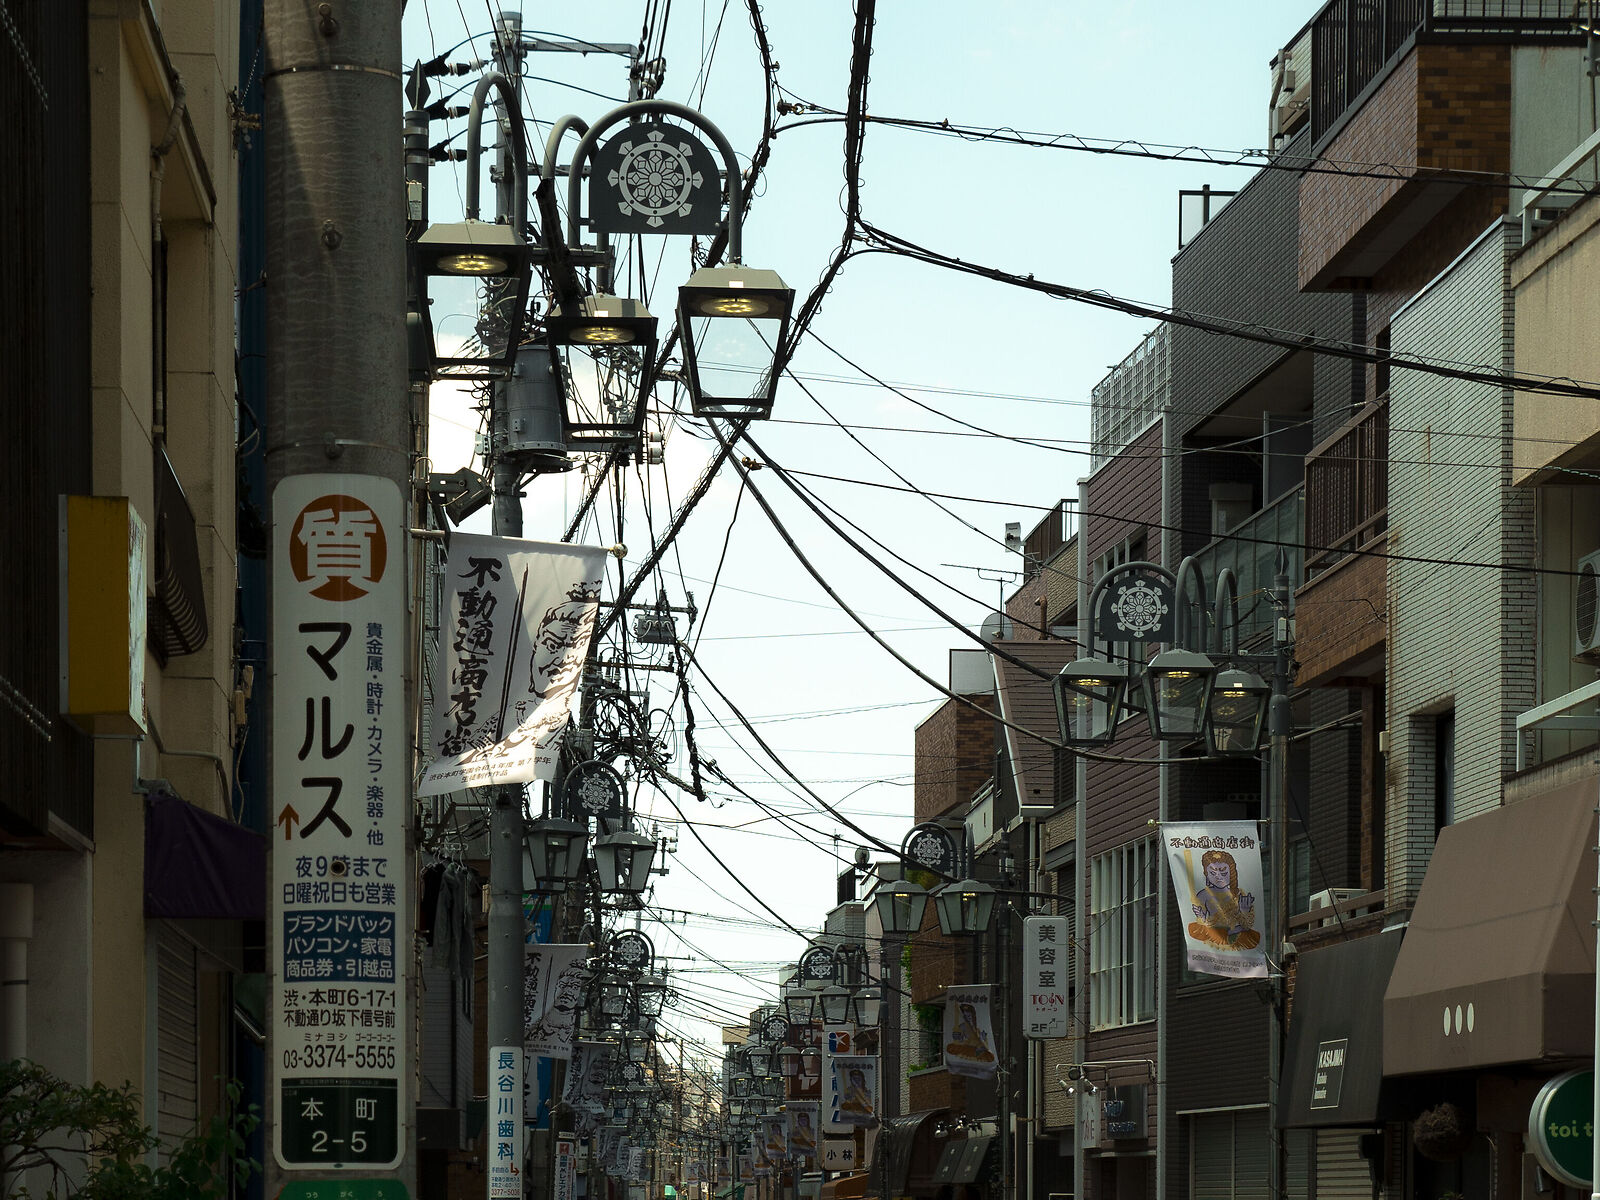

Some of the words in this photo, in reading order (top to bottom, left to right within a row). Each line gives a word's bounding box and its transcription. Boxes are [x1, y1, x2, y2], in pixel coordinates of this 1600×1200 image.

[437, 556, 502, 758] 不動通商店街
[298, 622, 354, 839] マルス
[366, 622, 384, 847] 貴金属・時計・カメラ・楽器・他
[284, 882, 396, 905] 日曜祝日も営業
[287, 915, 392, 934] ブランドバック
[287, 937, 392, 956] パソコン・家電
[1038, 925, 1056, 988] 美容室
[287, 958, 393, 978] 商品券・引越品
[284, 988, 396, 1008] 渋・本町6-17-1
[284, 1009, 396, 1029] 不動通り坂下信号前
[1031, 1023, 1047, 1033] 2F
[303, 1033, 347, 1042] ミナヨシ
[284, 1044, 396, 1070] 03-3374-5555
[301, 1097, 377, 1121] 本町
[497, 1051, 515, 1161] 長谷川歯科
[1548, 1119, 1579, 1138] toi
[311, 1130, 368, 1153] 2-5
